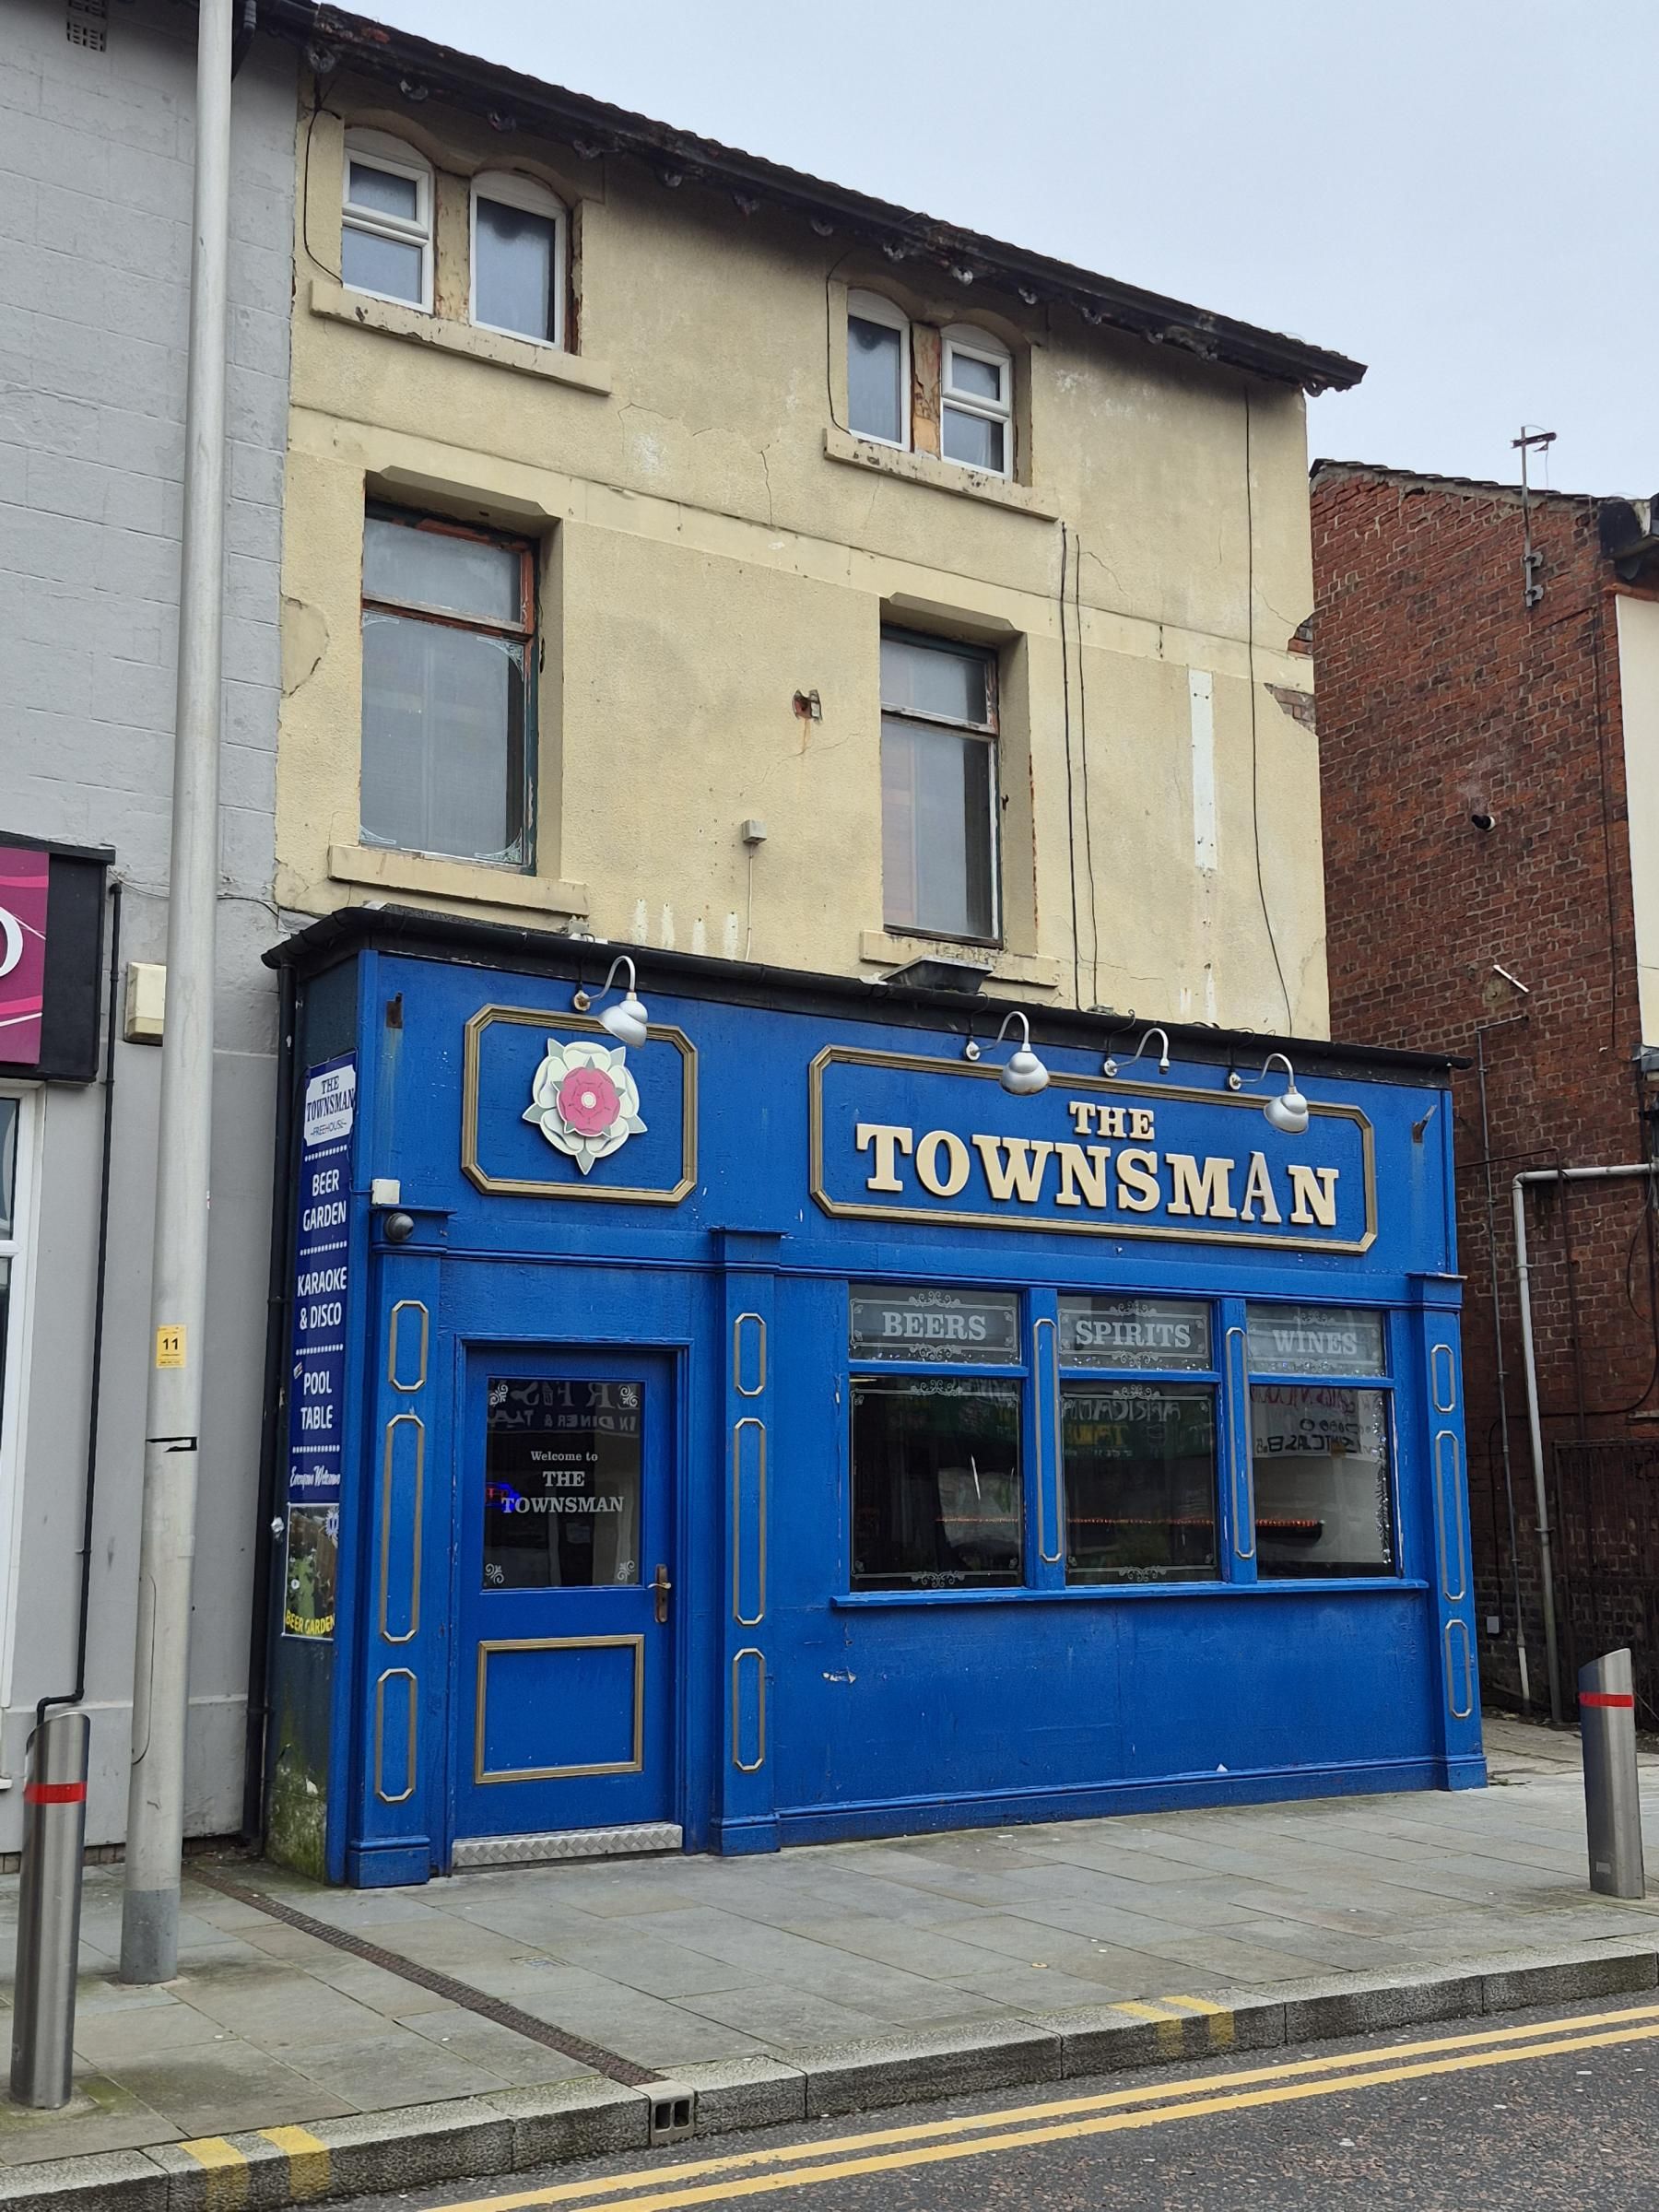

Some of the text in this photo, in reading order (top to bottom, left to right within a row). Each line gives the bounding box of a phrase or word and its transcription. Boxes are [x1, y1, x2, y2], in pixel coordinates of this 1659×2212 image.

[321, 1075, 340, 1095] THE
[306, 1088, 355, 1123] TOWNSMAN
[1069, 1100, 1155, 1141] THE
[312, 1169, 340, 1197] BEER
[856, 1123, 1339, 1226] TOWNSMAN
[302, 1201, 347, 1232] GARDEN
[297, 1265, 347, 1298] KARAOKE
[299, 1301, 342, 1331] & DISCO
[882, 1312, 987, 1341] BEERS
[162, 1337, 178, 1350] 11
[1075, 1320, 1192, 1349] SPIRITS
[1272, 1329, 1359, 1356] WINES
[303, 1371, 333, 1395] POOL
[300, 1405, 334, 1430] TABLE
[530, 1451, 598, 1462] Welcome to
[543, 1471, 585, 1487] THE
[501, 1497, 624, 1513] TOWNSMAN
[286, 1609, 335, 1635] BEER GARDEN
